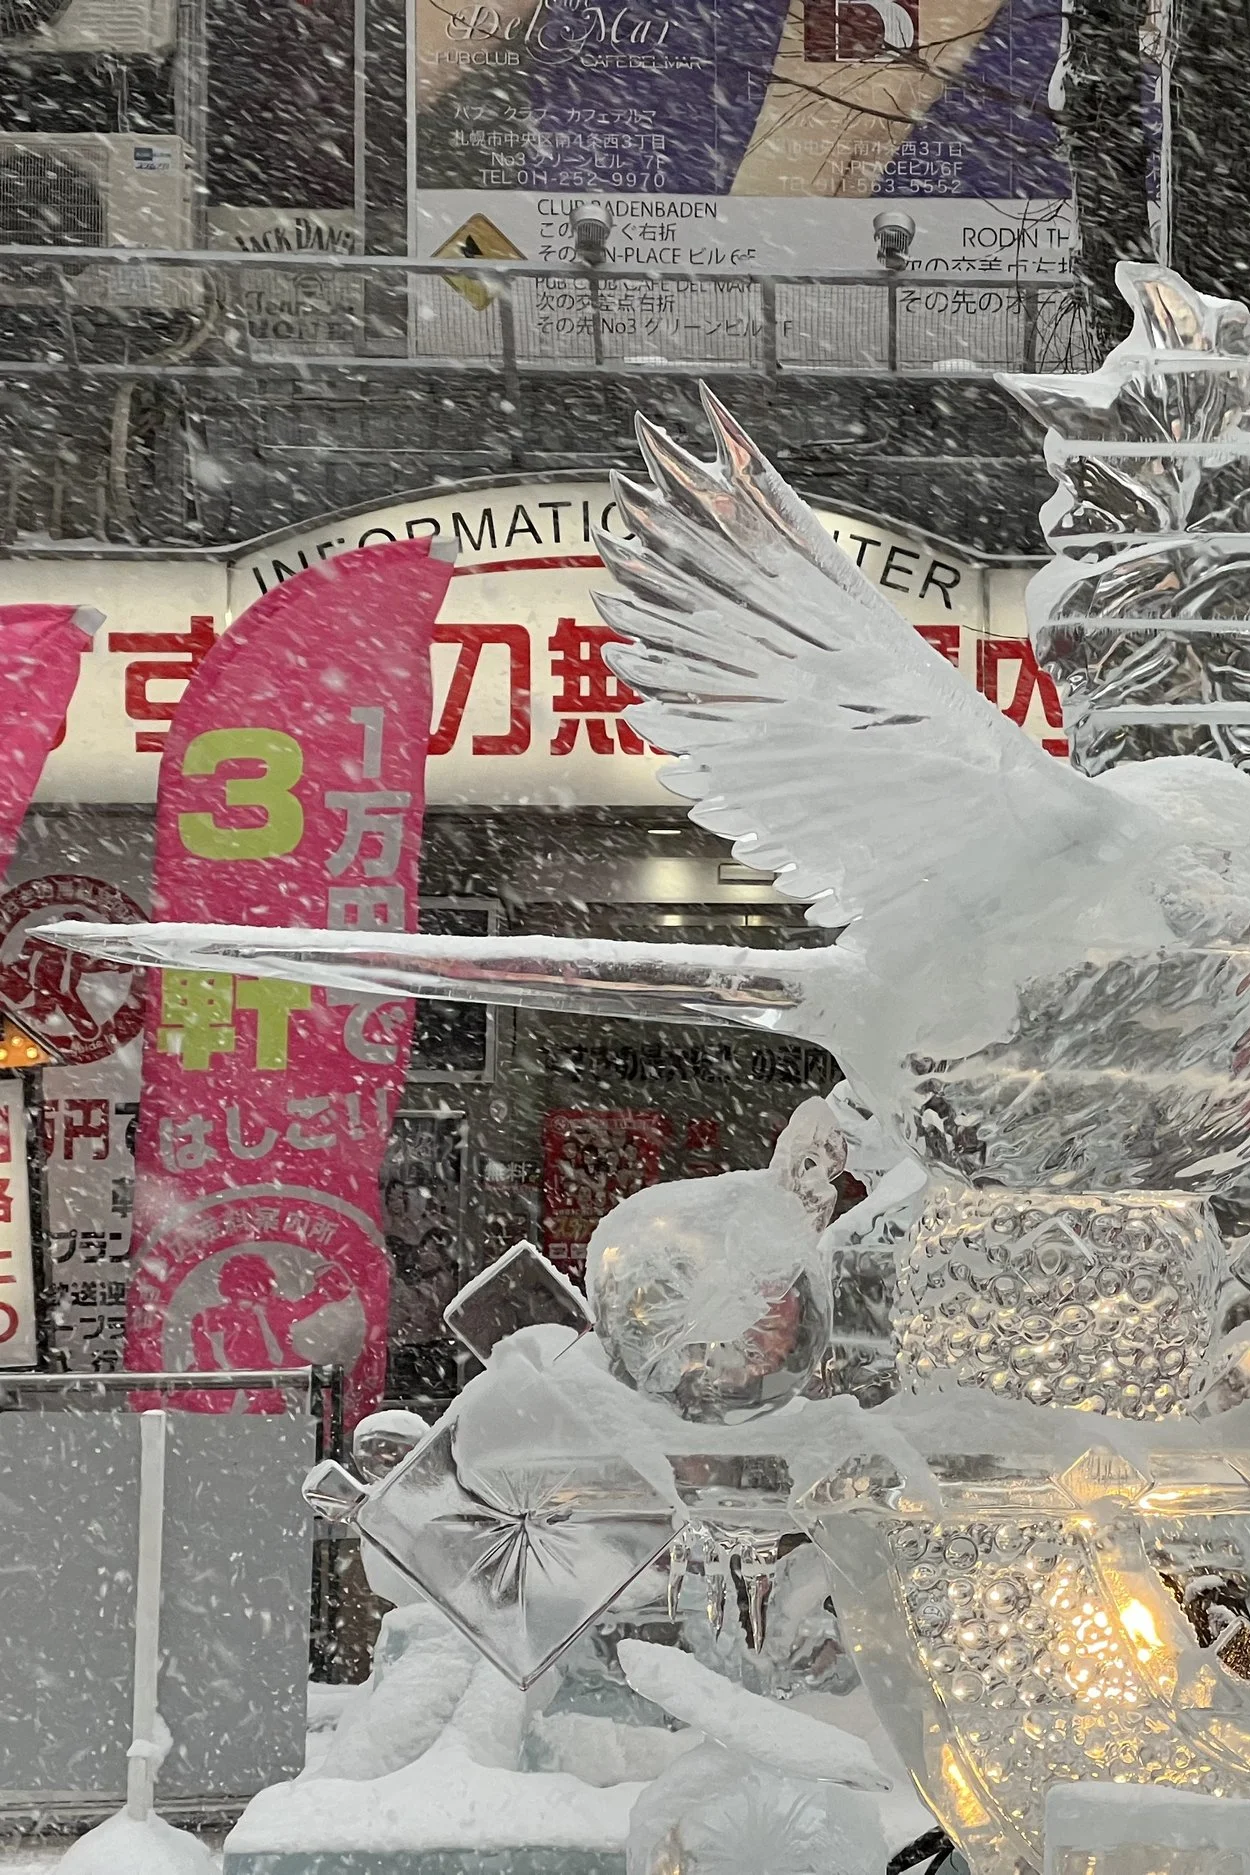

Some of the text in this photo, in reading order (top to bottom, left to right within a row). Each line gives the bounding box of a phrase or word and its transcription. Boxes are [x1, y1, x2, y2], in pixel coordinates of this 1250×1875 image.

[452, 130, 666, 151] 札幌市中央区南4条西3丁目
[537, 200, 718, 219] CLU ADENBADEN
[539, 221, 677, 243] このぐ右折
[962, 227, 1038, 248] RODIN
